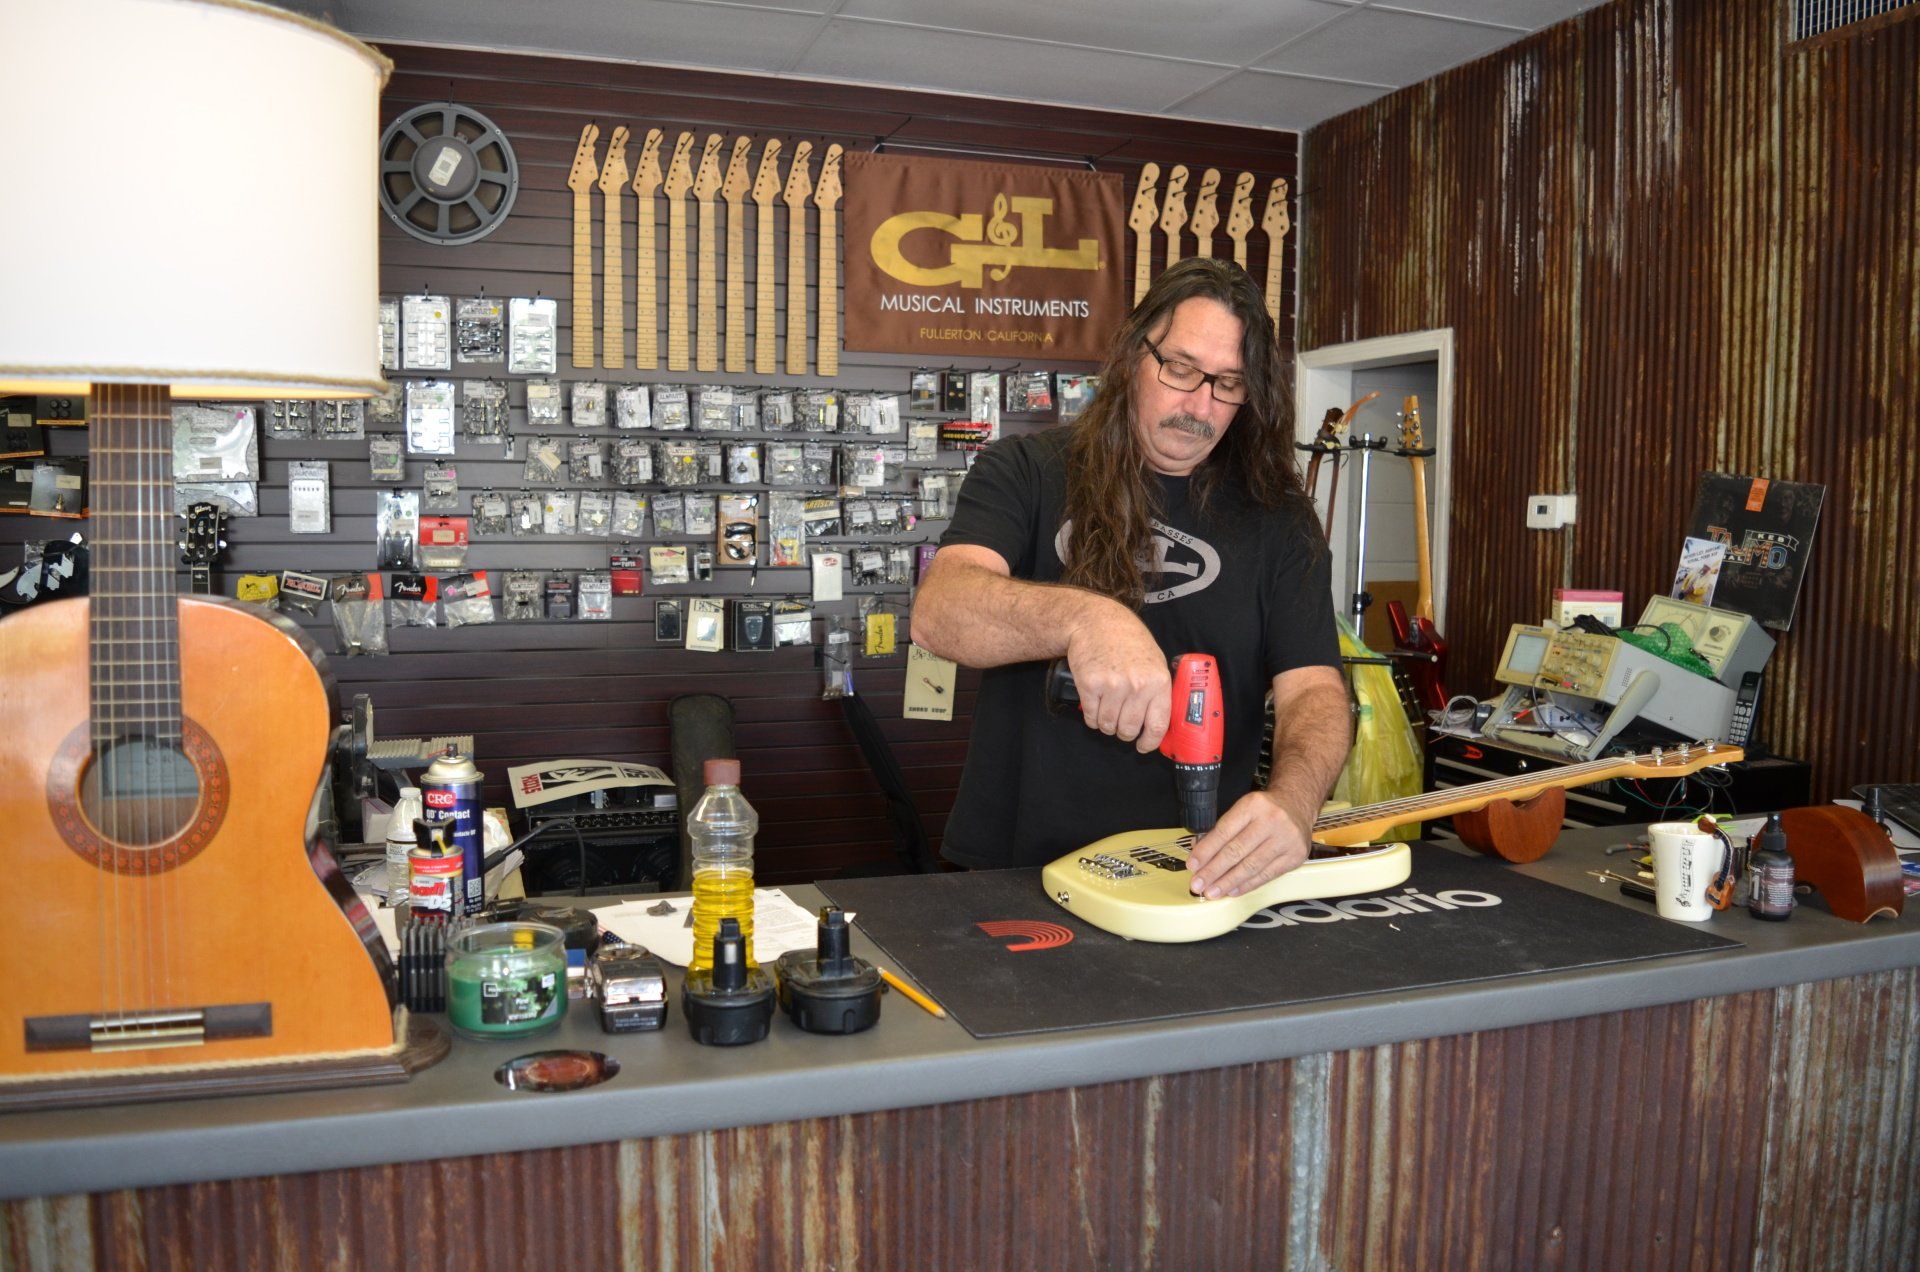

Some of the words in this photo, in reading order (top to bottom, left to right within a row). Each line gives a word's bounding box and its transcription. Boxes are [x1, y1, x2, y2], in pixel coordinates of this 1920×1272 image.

[880, 294, 965, 314] MUSICAL
[975, 298, 1090, 318] INSTRUMENTS
[987, 329, 1054, 343] CALIFORNIA
[1152, 520, 1193, 545] BASSES
[394, 581, 421, 594] Fender
[1157, 590, 1175, 601] CA
[427, 793, 453, 804] CRC
[438, 809, 471, 820] Contact
